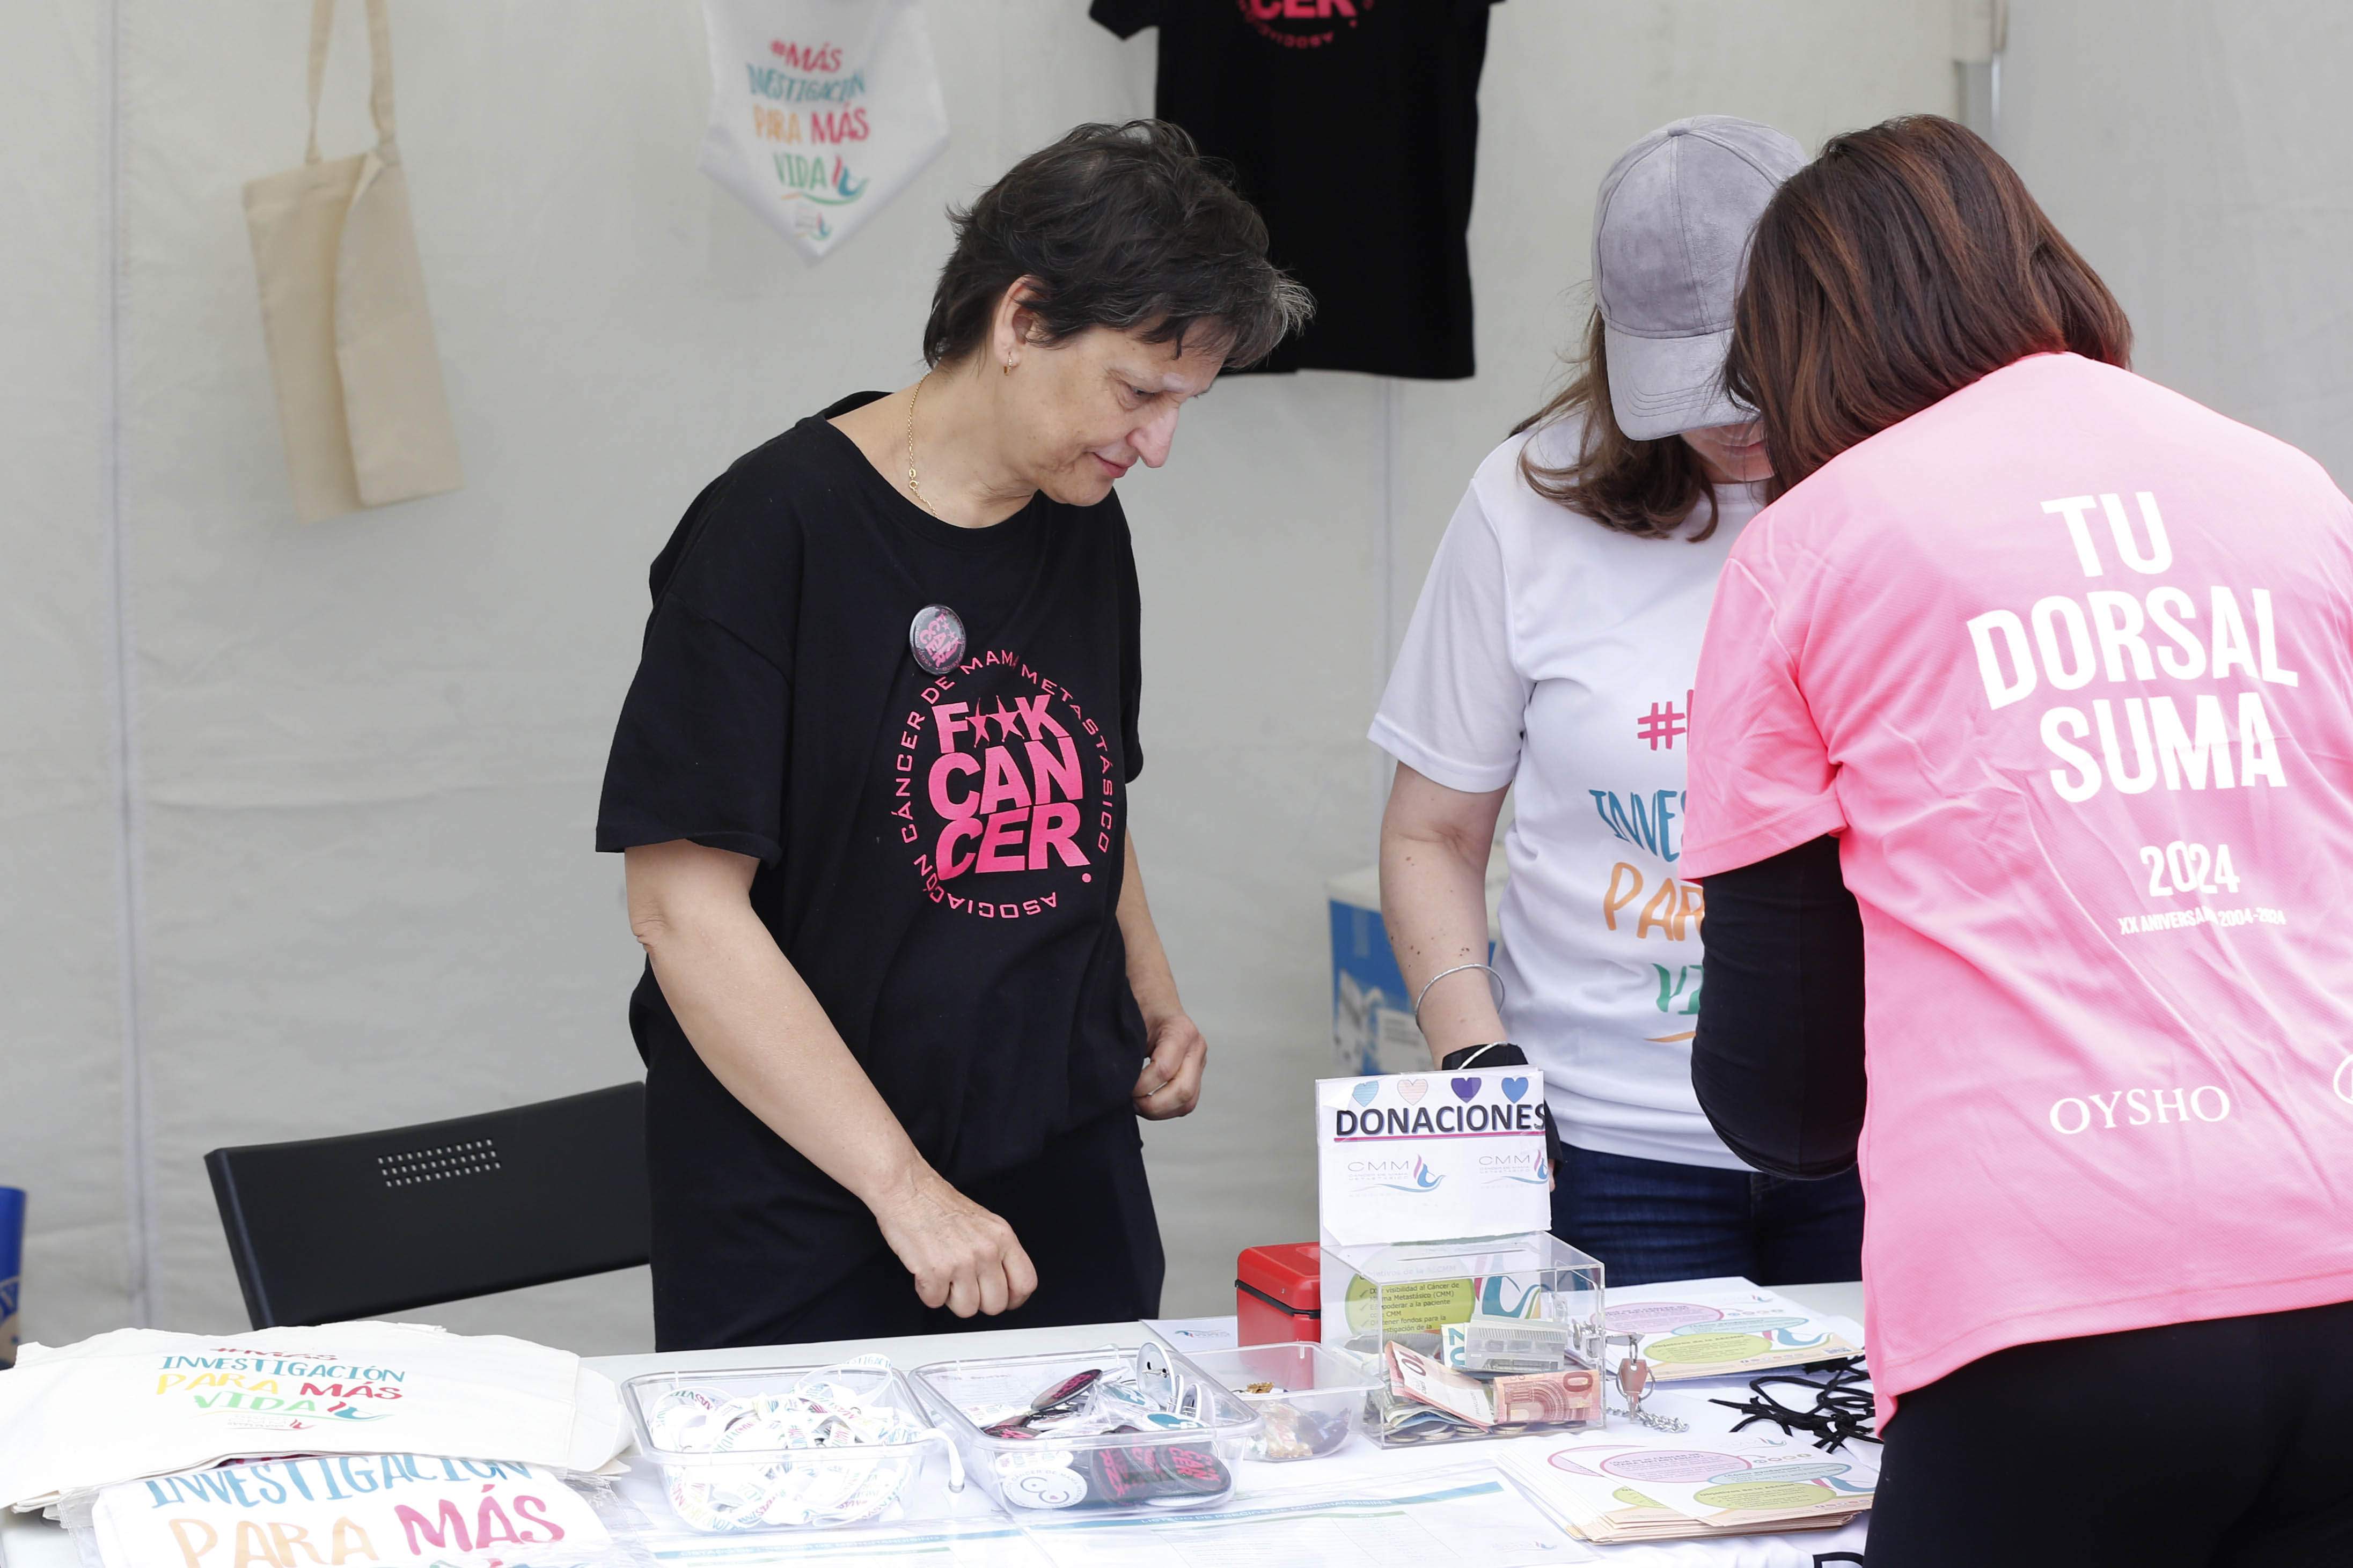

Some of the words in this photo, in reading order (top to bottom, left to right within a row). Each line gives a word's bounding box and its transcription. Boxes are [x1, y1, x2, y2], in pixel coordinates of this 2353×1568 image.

[753, 102, 802, 145] PARA
[811, 102, 870, 145] MÁS
[773, 152, 827, 190] VIDA
[2040, 491, 2173, 578] TU
[1966, 586, 2298, 711] DORSAL
[921, 676, 955, 705] DE
[1021, 664, 1114, 853] METASTÁSICO
[2040, 691, 2288, 803] SUMA
[891, 711, 926, 843] CÁNCER
[928, 736, 1083, 820] CAN
[2139, 840, 2241, 897] 2024
[913, 854, 1057, 919] ASOCIACÓN
[2117, 917, 2140, 935] XX
[1336, 1103, 1545, 1136] DONACIONES
[2049, 1085, 2231, 1135] OYSHO
[1347, 1160, 1409, 1172] CMM
[1479, 1154, 1530, 1166] CMM
[1370, 1302, 1408, 1311] Epoderar
[1423, 1299, 1451, 1308] paciente
[1394, 1292, 1432, 1301] Metastásico
[1433, 1291, 1454, 1299] (CMM)
[1401, 1316, 1423, 1324] fondos
[158, 1356, 405, 1382] INVESTIGACIÓN
[1399, 1351, 1426, 1376] 10
[157, 1372, 278, 1395] PARA
[299, 1382, 403, 1400] MÁS
[193, 1390, 316, 1411] VIDA
[169, 1516, 379, 1568] PARA
[394, 1484, 565, 1556] MÁS
